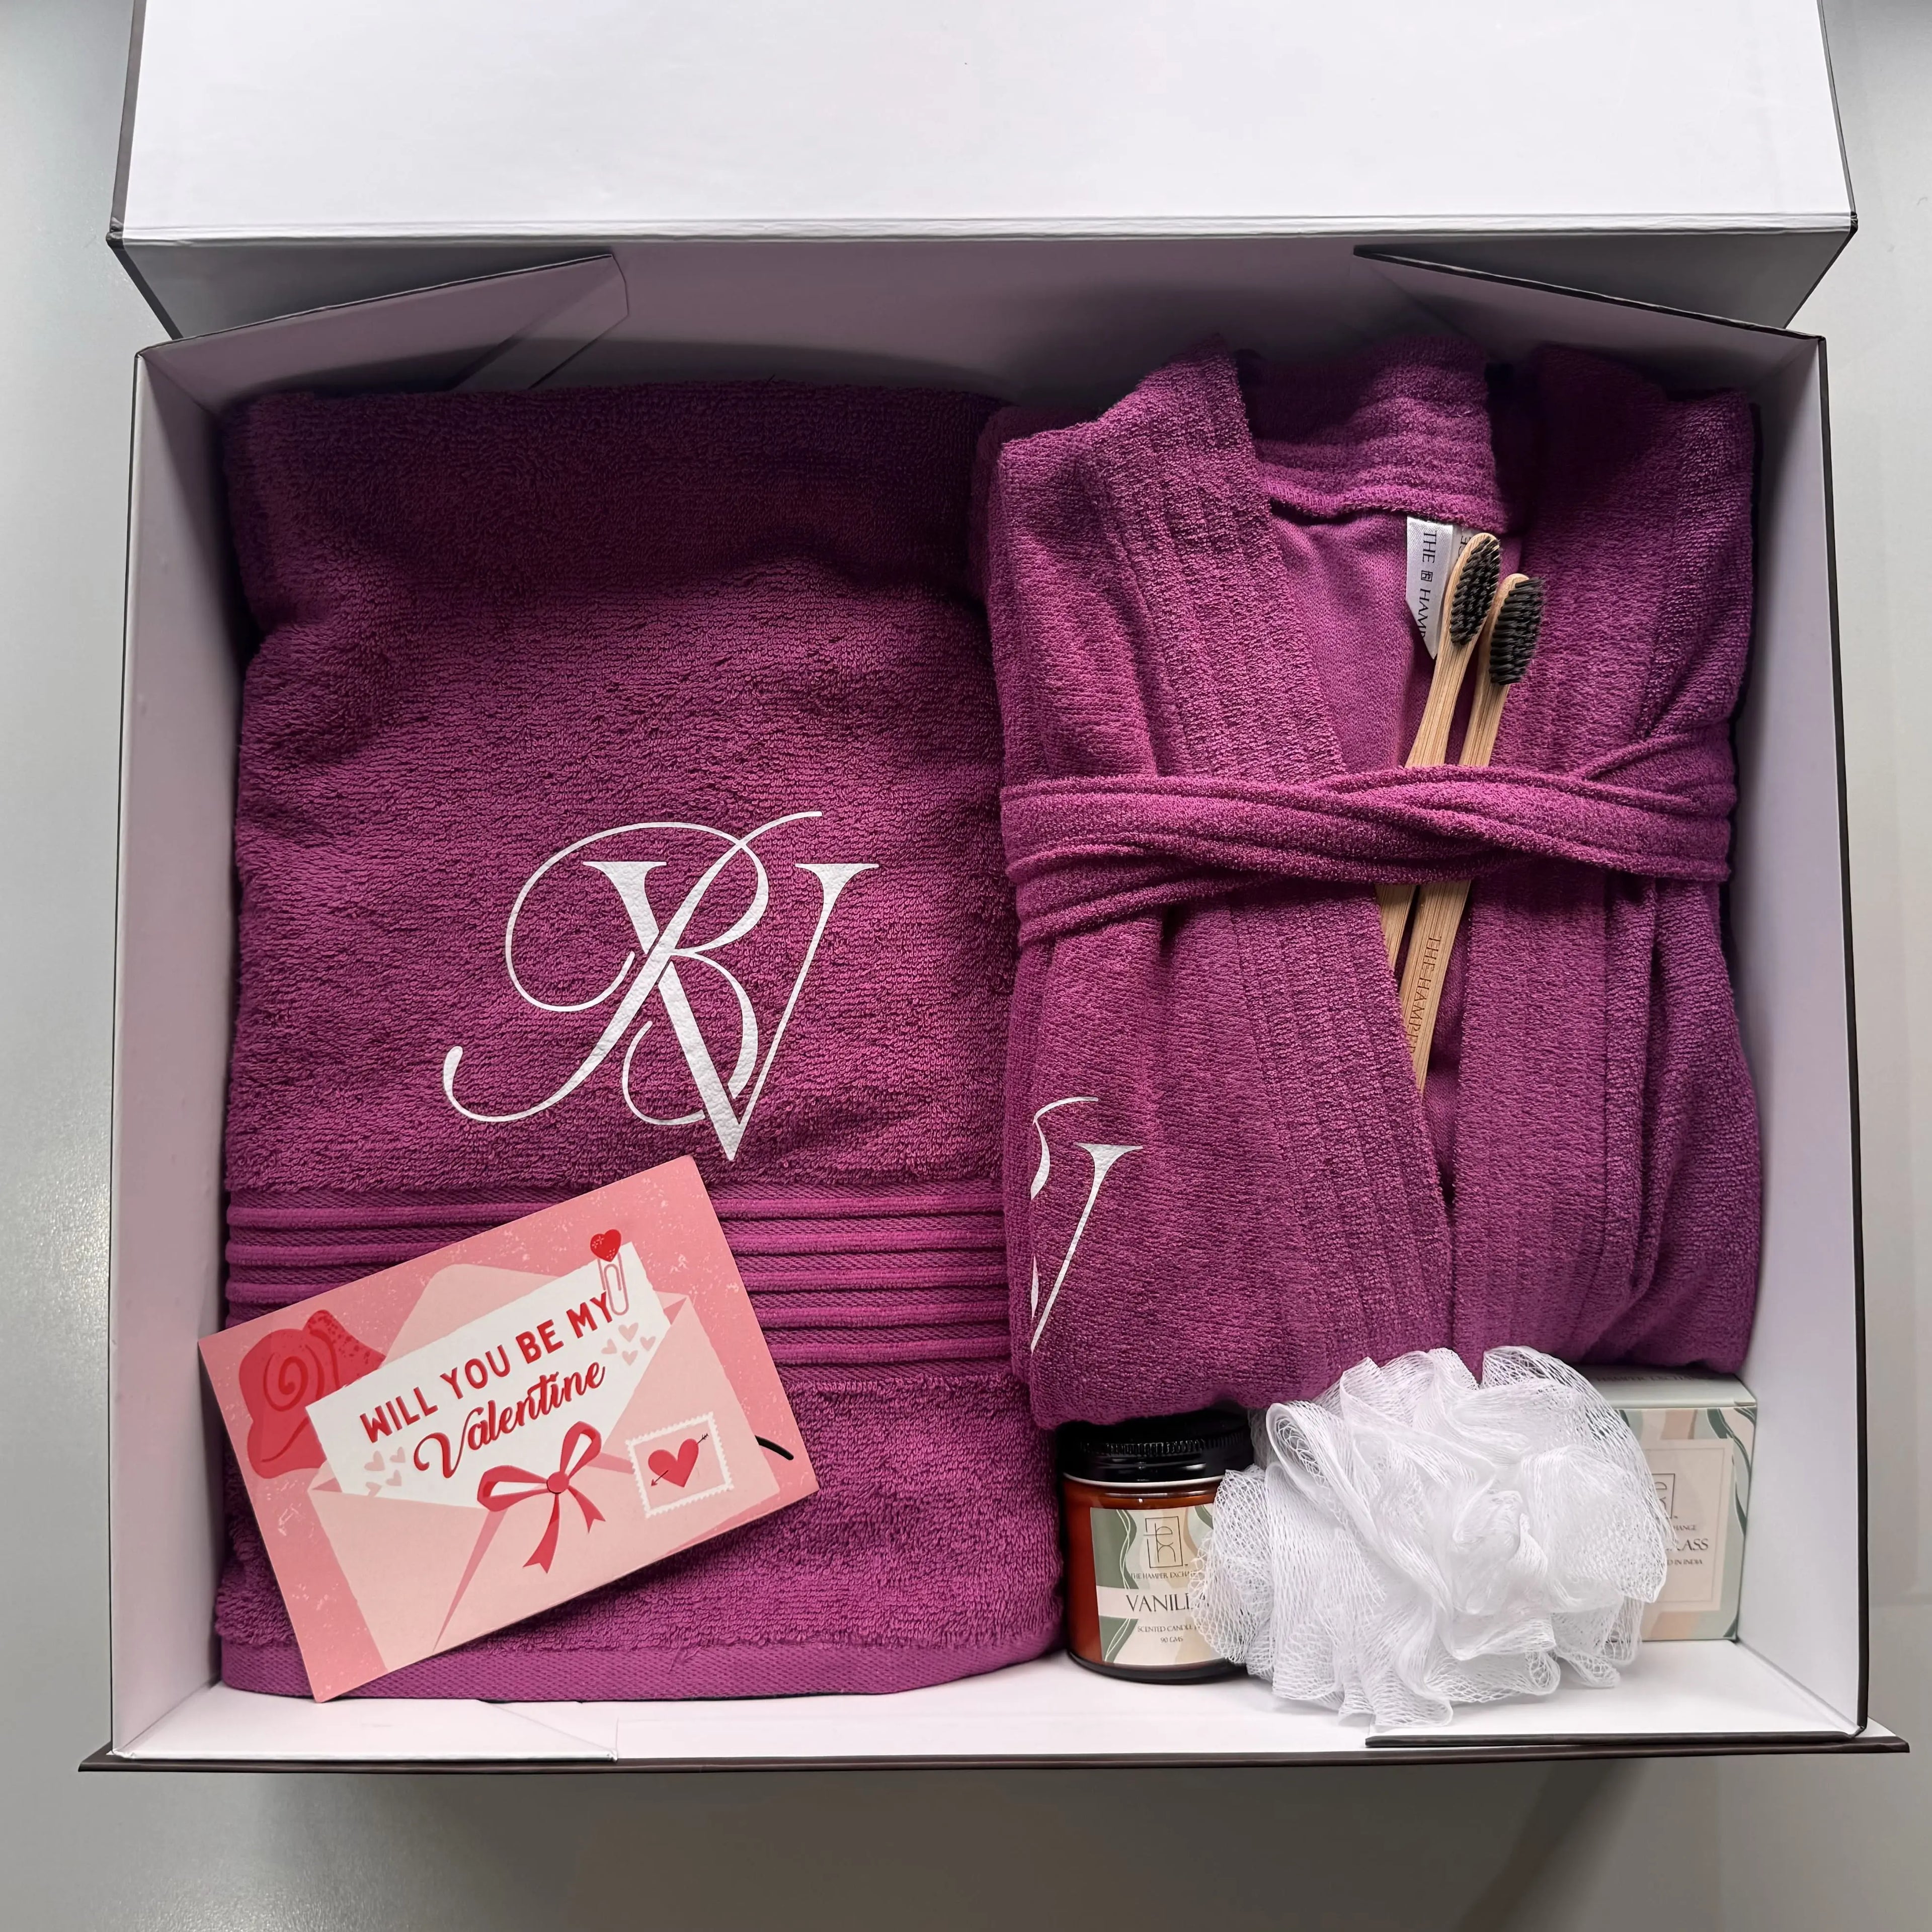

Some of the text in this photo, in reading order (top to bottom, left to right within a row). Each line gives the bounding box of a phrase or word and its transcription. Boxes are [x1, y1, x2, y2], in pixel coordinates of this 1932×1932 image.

[1422, 530, 1437, 564] THE
[1421, 936, 1442, 972] THE
[359, 1291, 613, 1443] WILL YOU BE MY
[413, 1361, 606, 1479] Valentine
